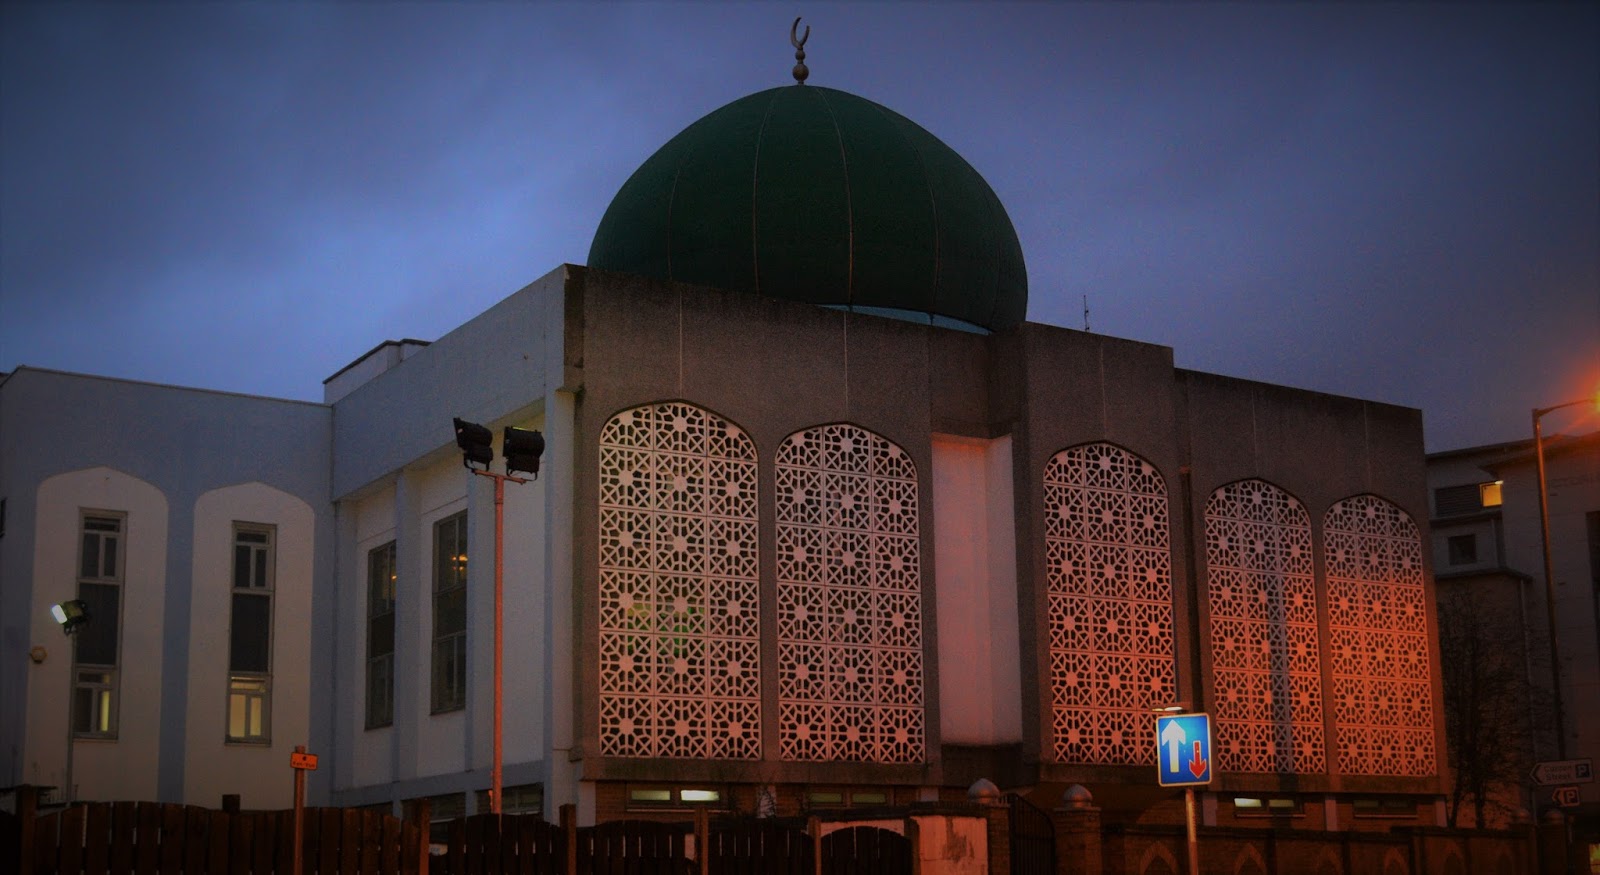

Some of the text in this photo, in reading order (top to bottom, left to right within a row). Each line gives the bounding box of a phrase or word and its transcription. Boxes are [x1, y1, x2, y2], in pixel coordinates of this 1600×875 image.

[1577, 765, 1586, 776] P
[1546, 773, 1571, 781] Street
[1566, 790, 1576, 802] P
